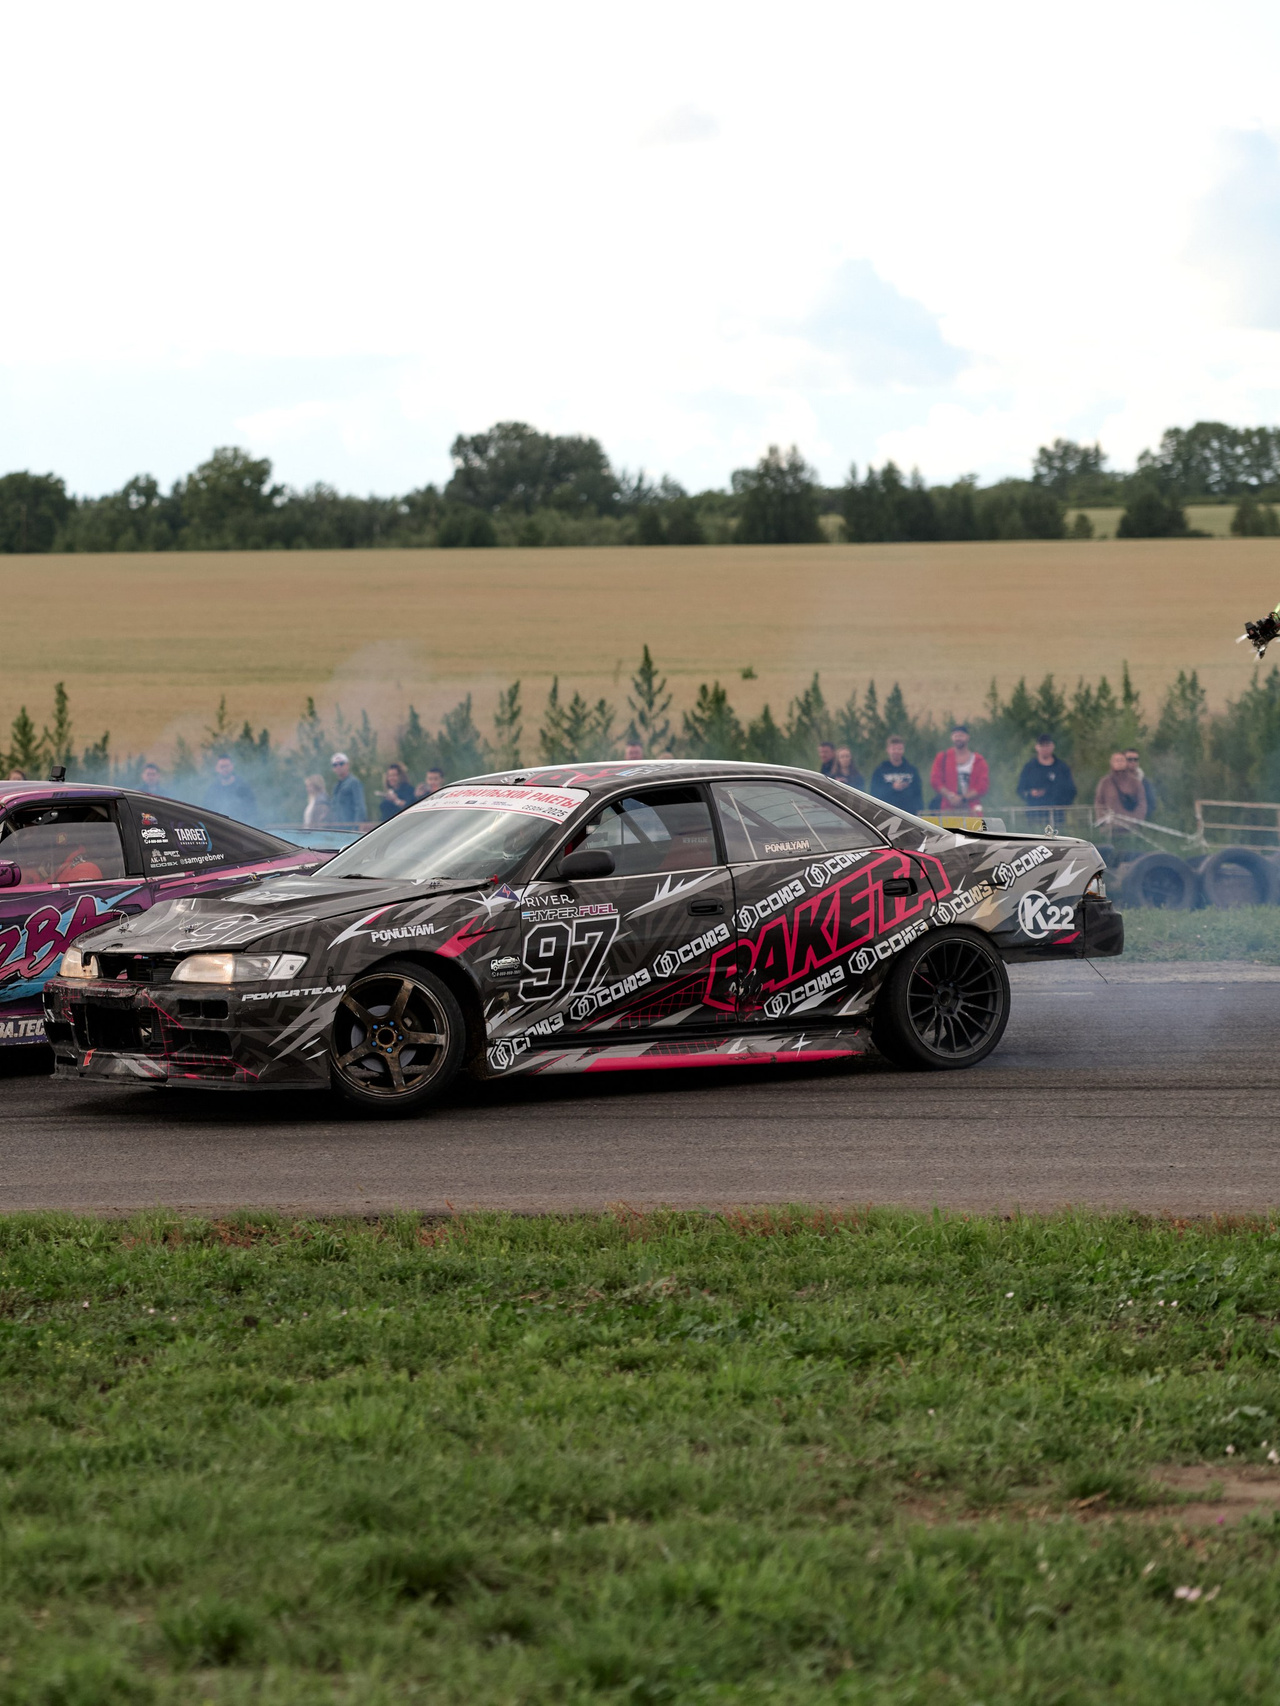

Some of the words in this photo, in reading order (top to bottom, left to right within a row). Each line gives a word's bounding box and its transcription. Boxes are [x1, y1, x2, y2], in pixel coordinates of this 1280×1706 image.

[444, 789, 533, 801] БАРНАУЛЬСКОЙ
[527, 792, 581, 809] РАКЕТЫ
[542, 806, 568, 818] 2025
[174, 828, 207, 841] TARGET
[765, 839, 810, 853] PONULYAM
[180, 853, 224, 865] @samgrebnev
[1011, 845, 1053, 877] СОЮЗ
[525, 894, 575, 907] RIVER
[755, 879, 806, 919] СОЮЗ
[952, 879, 994, 915] СОЮЗ
[171, 914, 318, 951] 97
[370, 923, 435, 943] PONULYAM
[678, 922, 731, 964] СОЮЗ
[702, 848, 952, 1011] РАКЕТА
[876, 919, 929, 960] СОЮЗ
[518, 915, 620, 1002] 97
[597, 967, 652, 1007] СОЮЗ
[792, 965, 845, 1003] СОЮЗ
